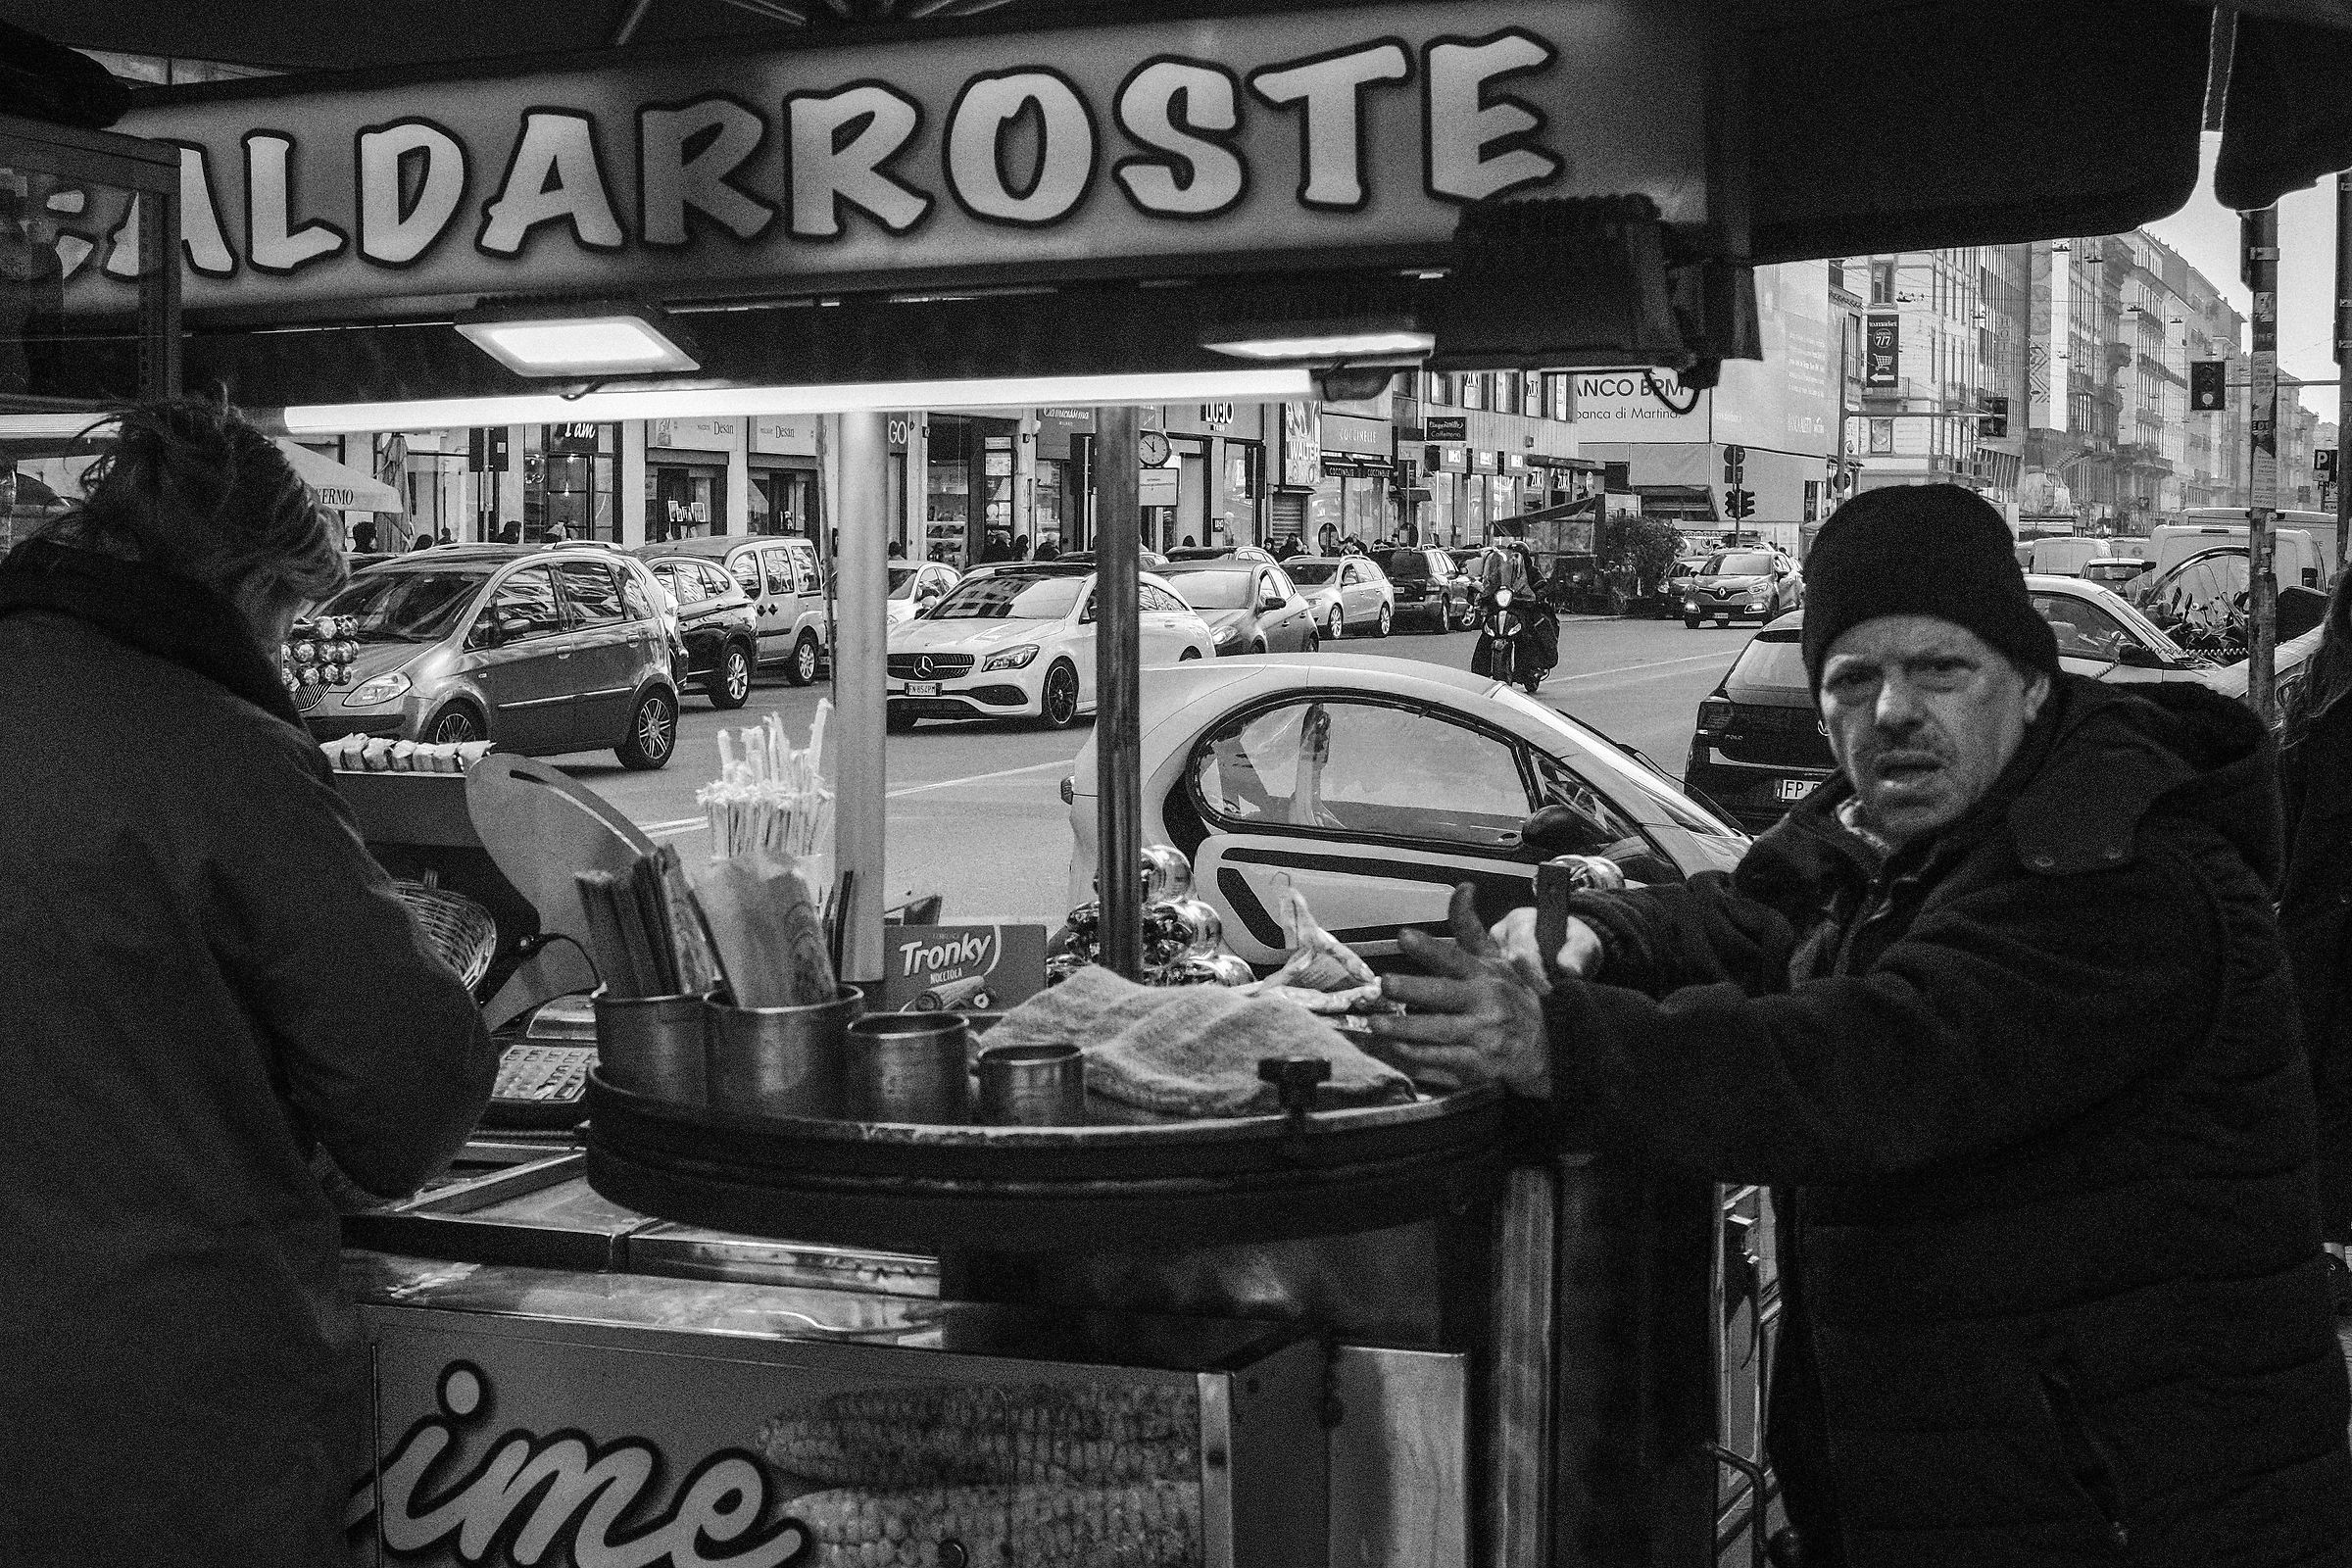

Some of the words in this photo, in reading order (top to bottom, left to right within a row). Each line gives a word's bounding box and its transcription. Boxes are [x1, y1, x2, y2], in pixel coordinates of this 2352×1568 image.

[1875, 335, 1891, 346] 7/7
[1615, 406, 1627, 419] di
[573, 422, 596, 439] am
[2316, 451, 2328, 469] P
[317, 487, 354, 506] ERMO
[899, 931, 993, 977] Tronky
